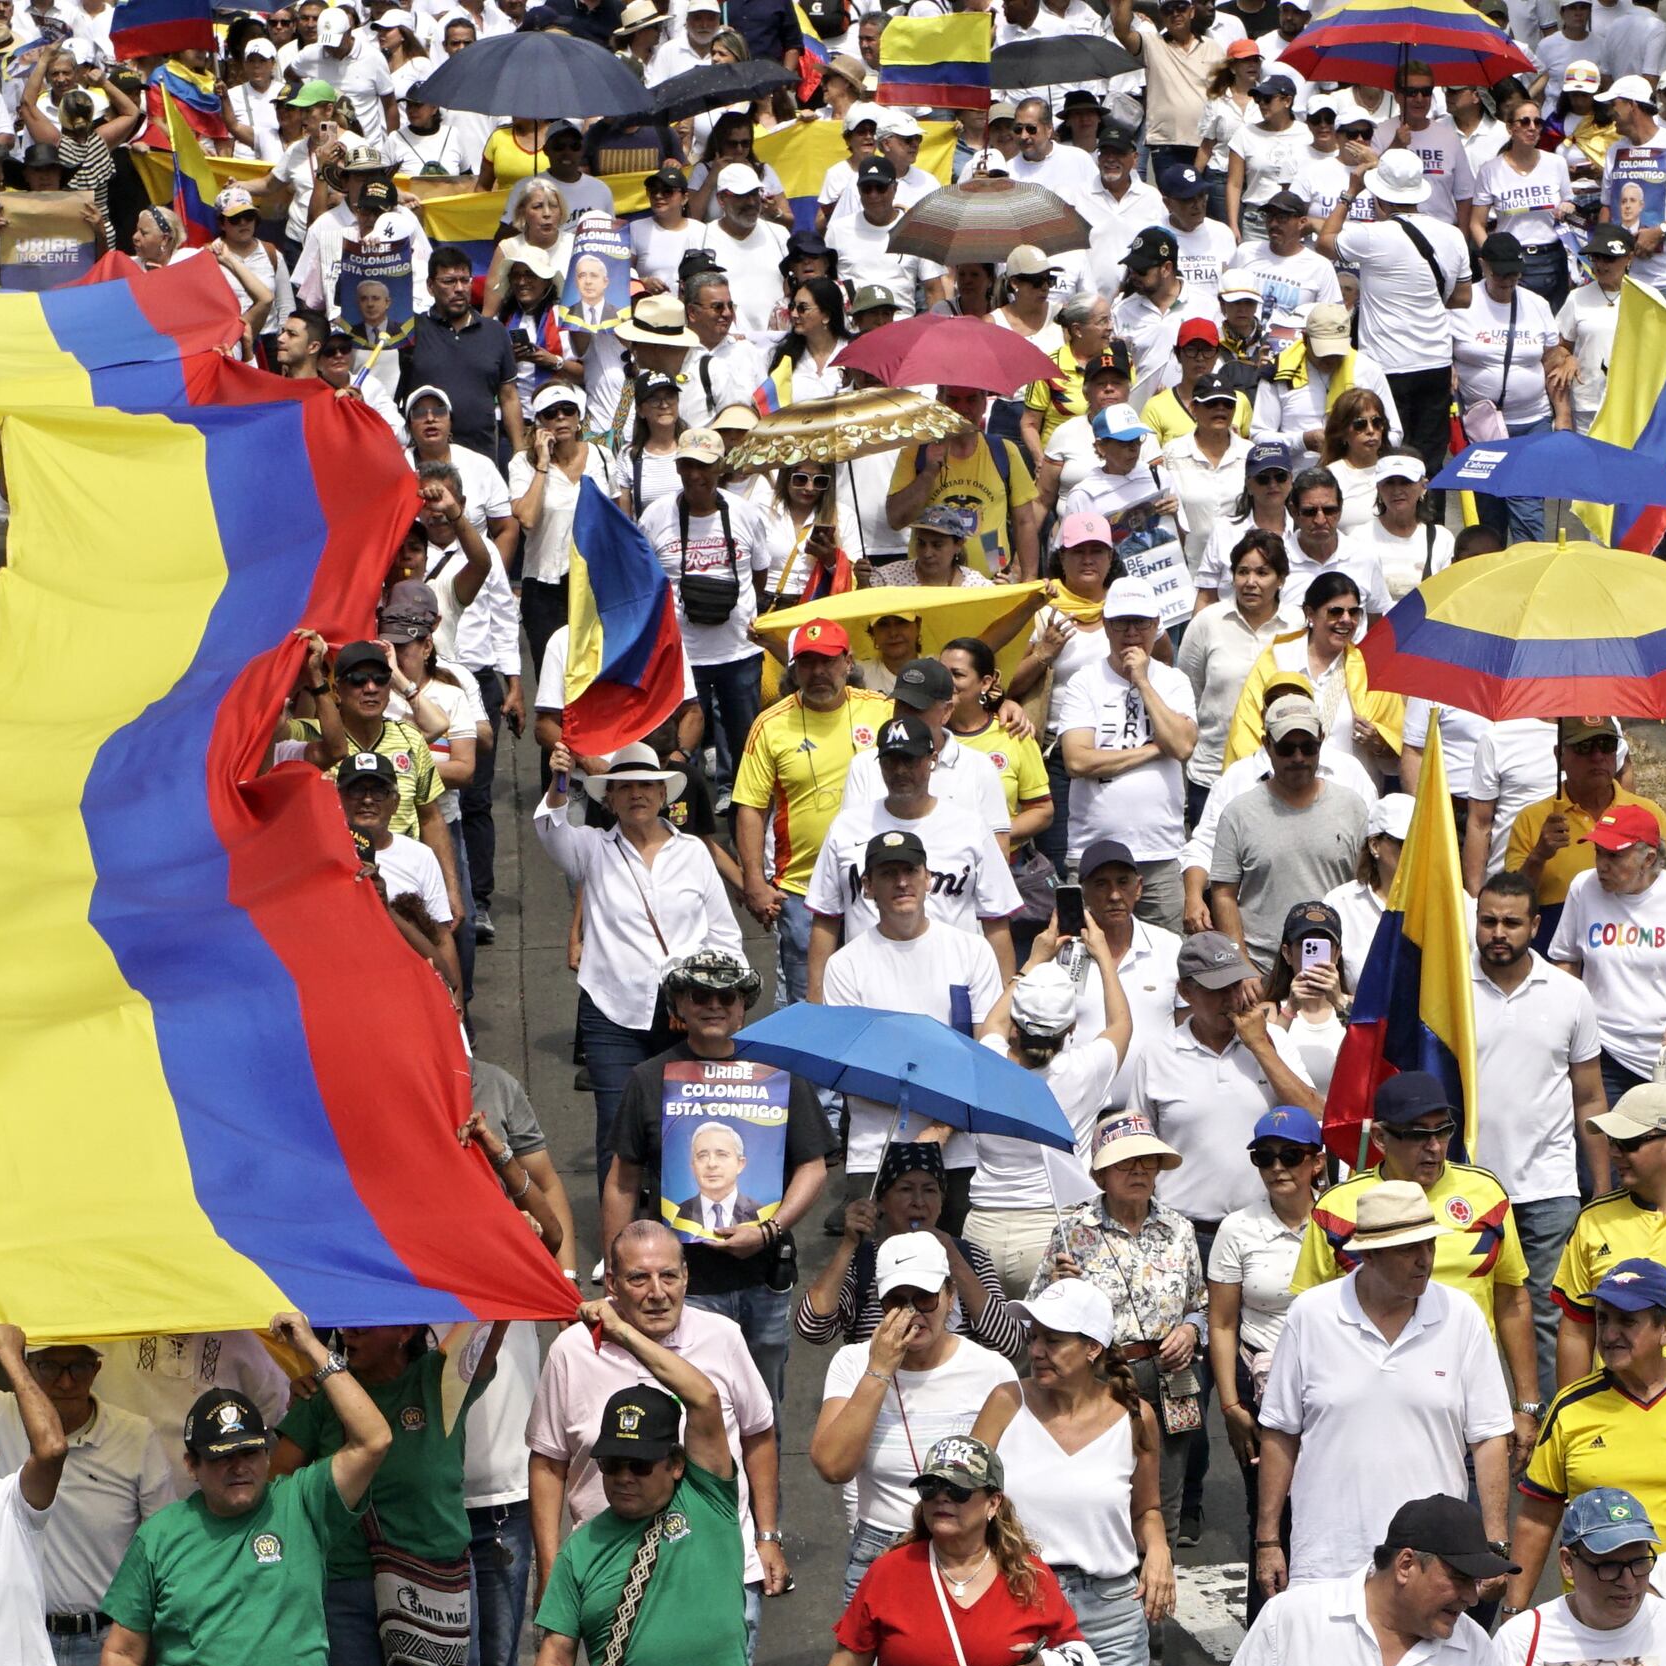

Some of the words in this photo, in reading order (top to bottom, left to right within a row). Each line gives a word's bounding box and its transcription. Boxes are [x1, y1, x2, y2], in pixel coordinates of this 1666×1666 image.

[1420, 149, 1444, 160] IBE
[1501, 185, 1552, 201] URIBE
[1501, 196, 1552, 211] INOCENTE
[15, 234, 80, 252] URIBE
[15, 250, 80, 265] INOCENTE
[349, 253, 402, 266] COLOMBIA
[584, 245, 631, 259] CONTIGO
[364, 263, 411, 277] CONTIGO
[1183, 269, 1219, 281] TRIA
[703, 1062, 755, 1081] URIBE
[680, 1082, 771, 1101] COLOMBIA
[665, 1101, 709, 1119] ESTA
[709, 1101, 784, 1121] CONTIGO
[411, 1599, 444, 1620] SANTA
